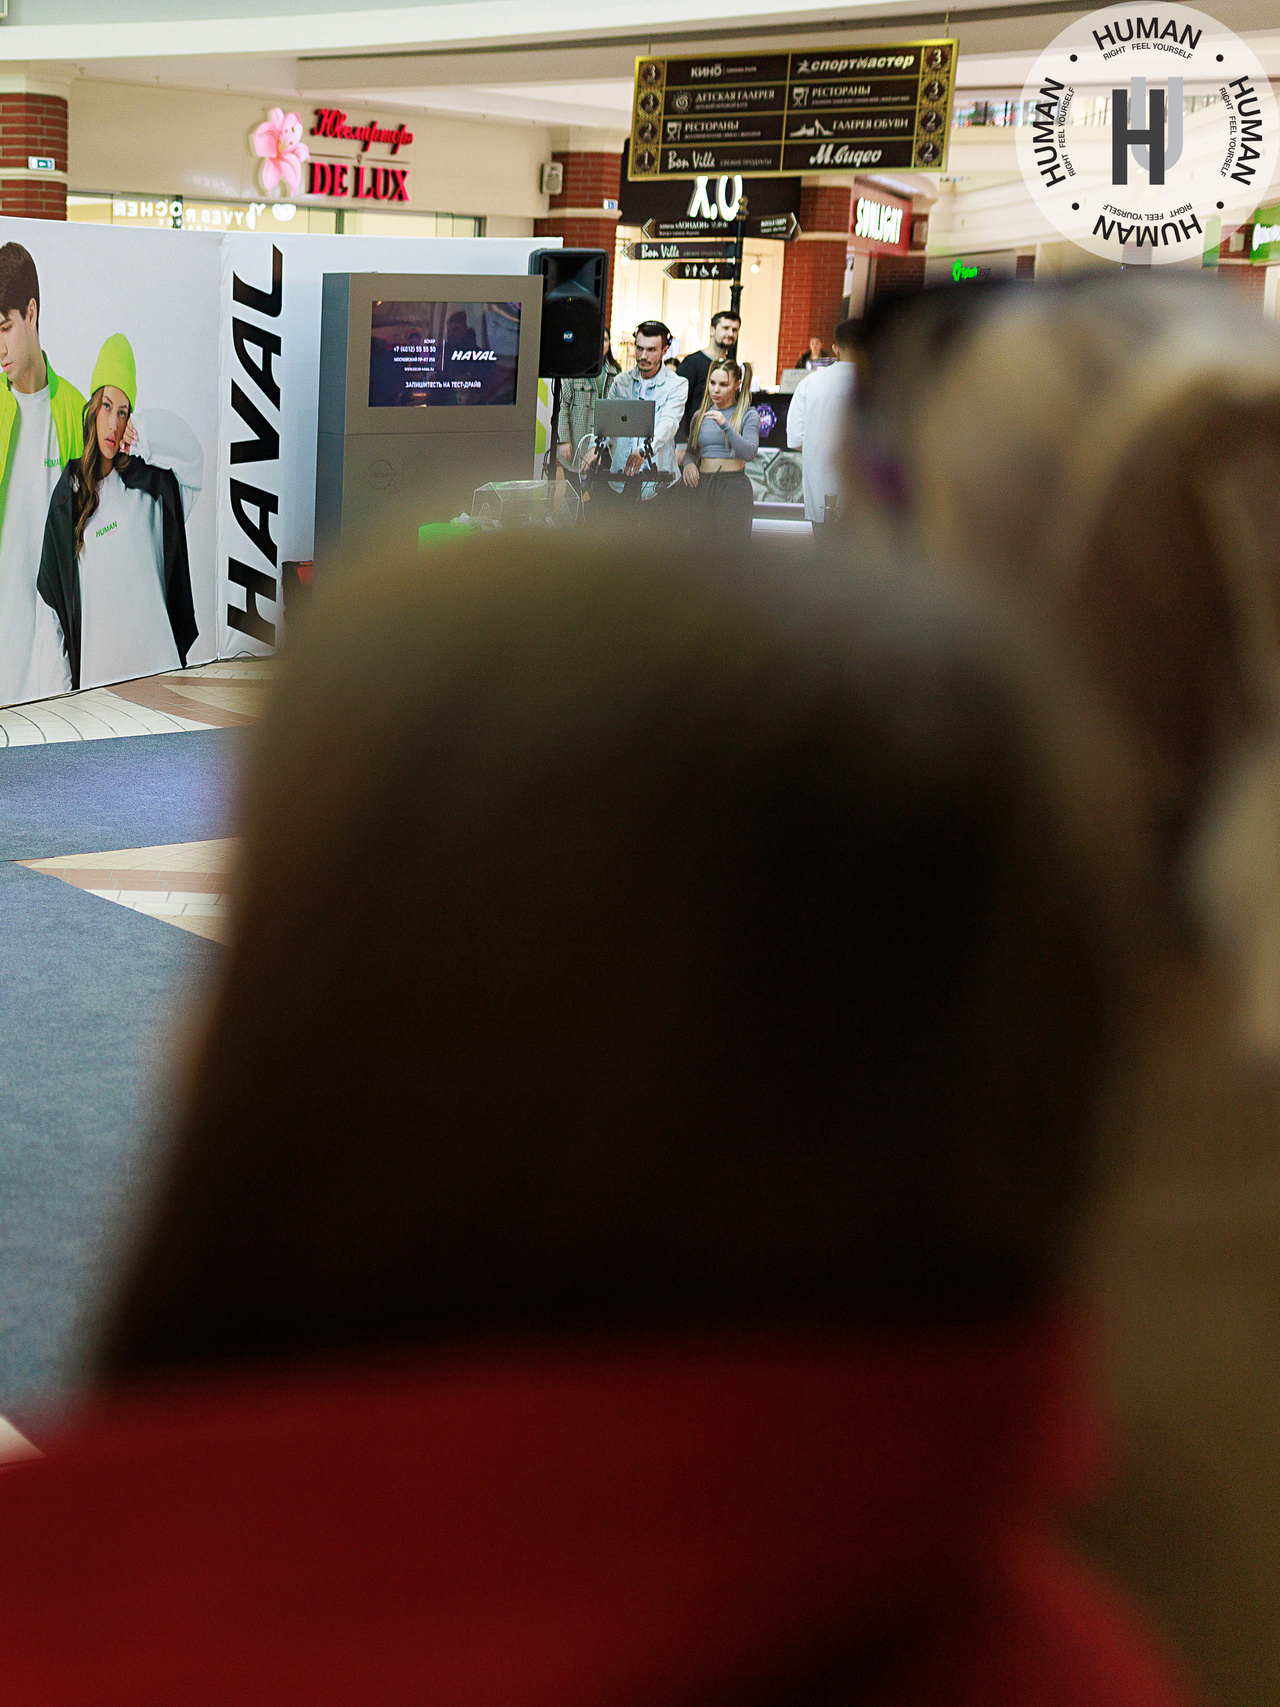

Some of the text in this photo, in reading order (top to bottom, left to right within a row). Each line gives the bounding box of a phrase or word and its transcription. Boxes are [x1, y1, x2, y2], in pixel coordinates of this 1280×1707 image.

[812, 84, 871, 97] РЕСТОРАНЫ
[684, 120, 739, 132] РЕСТОРАНЫ
[832, 117, 909, 131] ГАЛЕРЕЯ ОБУВИ
[667, 149, 716, 170] Bon Ville
[310, 162, 410, 201] DE LUX
[641, 243, 660, 259] Bon
[660, 243, 680, 259] Ville
[451, 350, 498, 361] HAVAL
[226, 243, 284, 648] HAVAL
[95, 520, 118, 538] HUMAN
